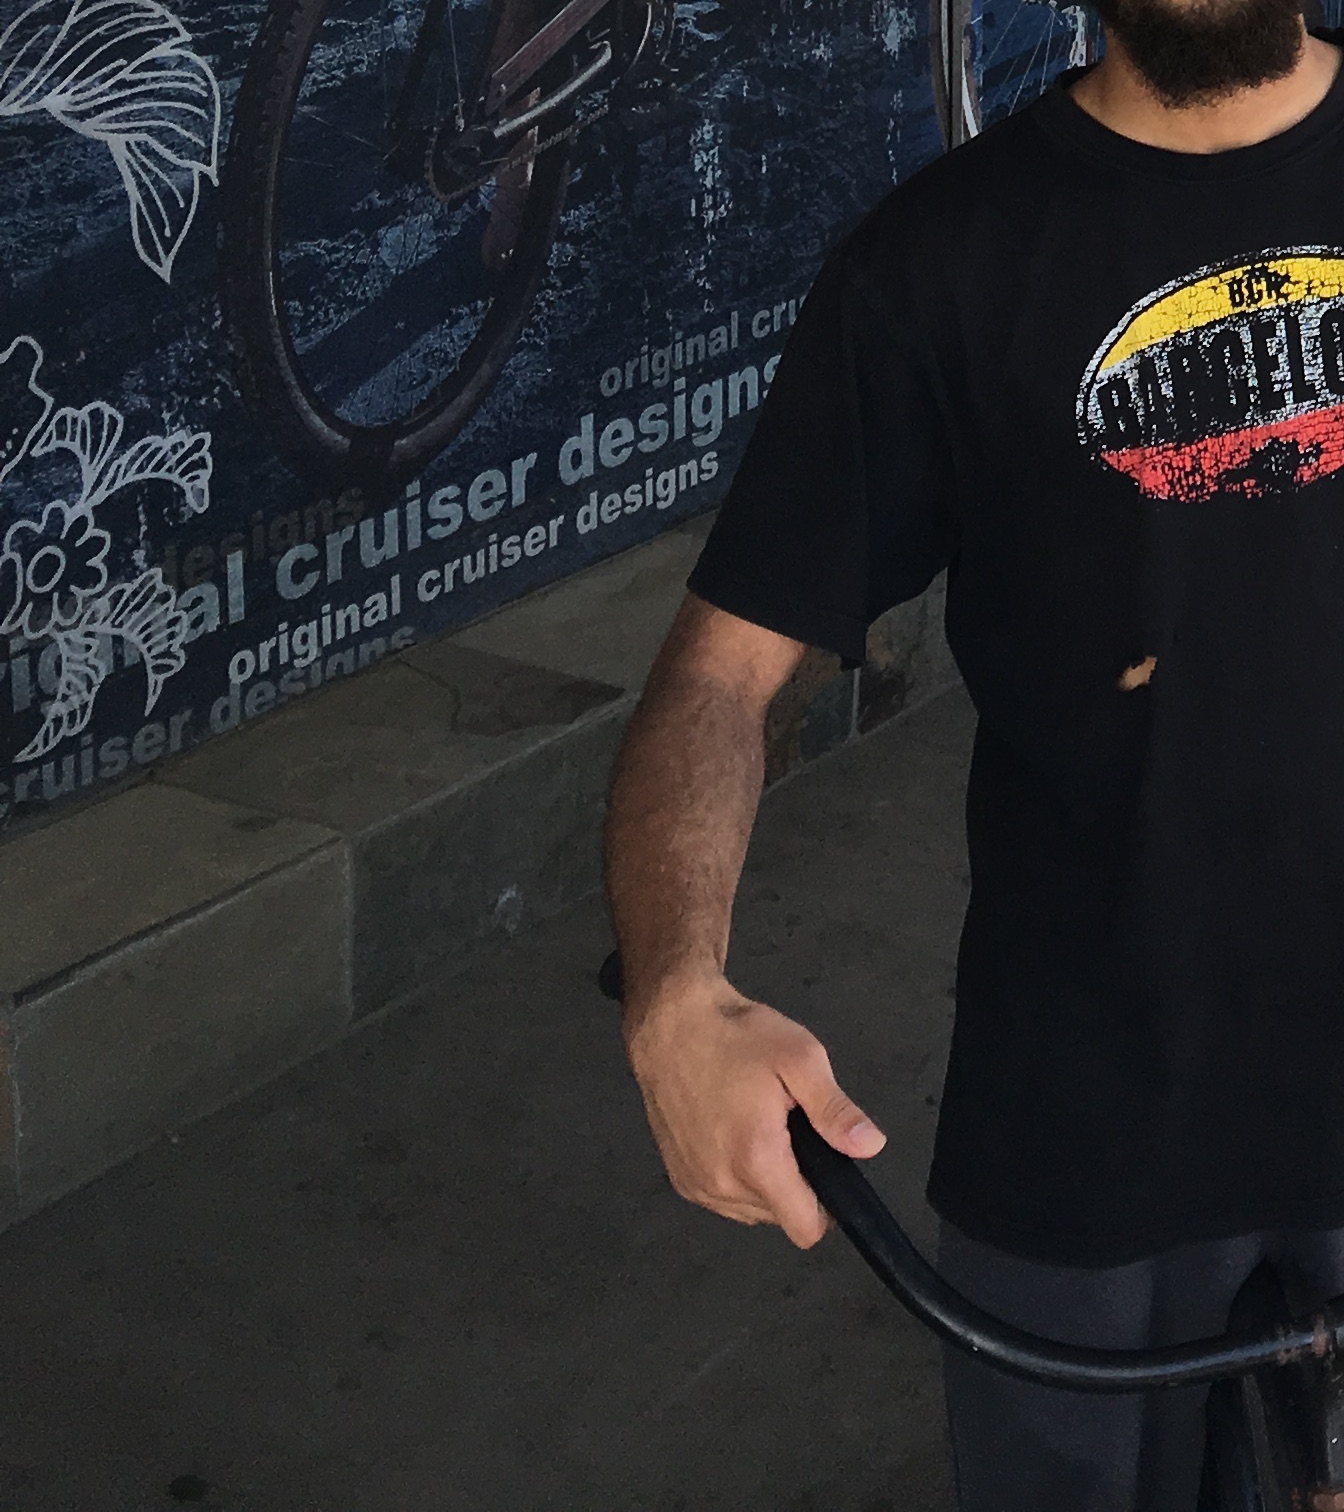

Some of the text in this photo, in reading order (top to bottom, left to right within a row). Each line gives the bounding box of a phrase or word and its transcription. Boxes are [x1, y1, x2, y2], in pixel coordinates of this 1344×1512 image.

[600, 309, 740, 398] original
[228, 451, 720, 687] original cruiser designs
[276, 448, 538, 601] cruiser
[0, 708, 193, 816] ruiser
